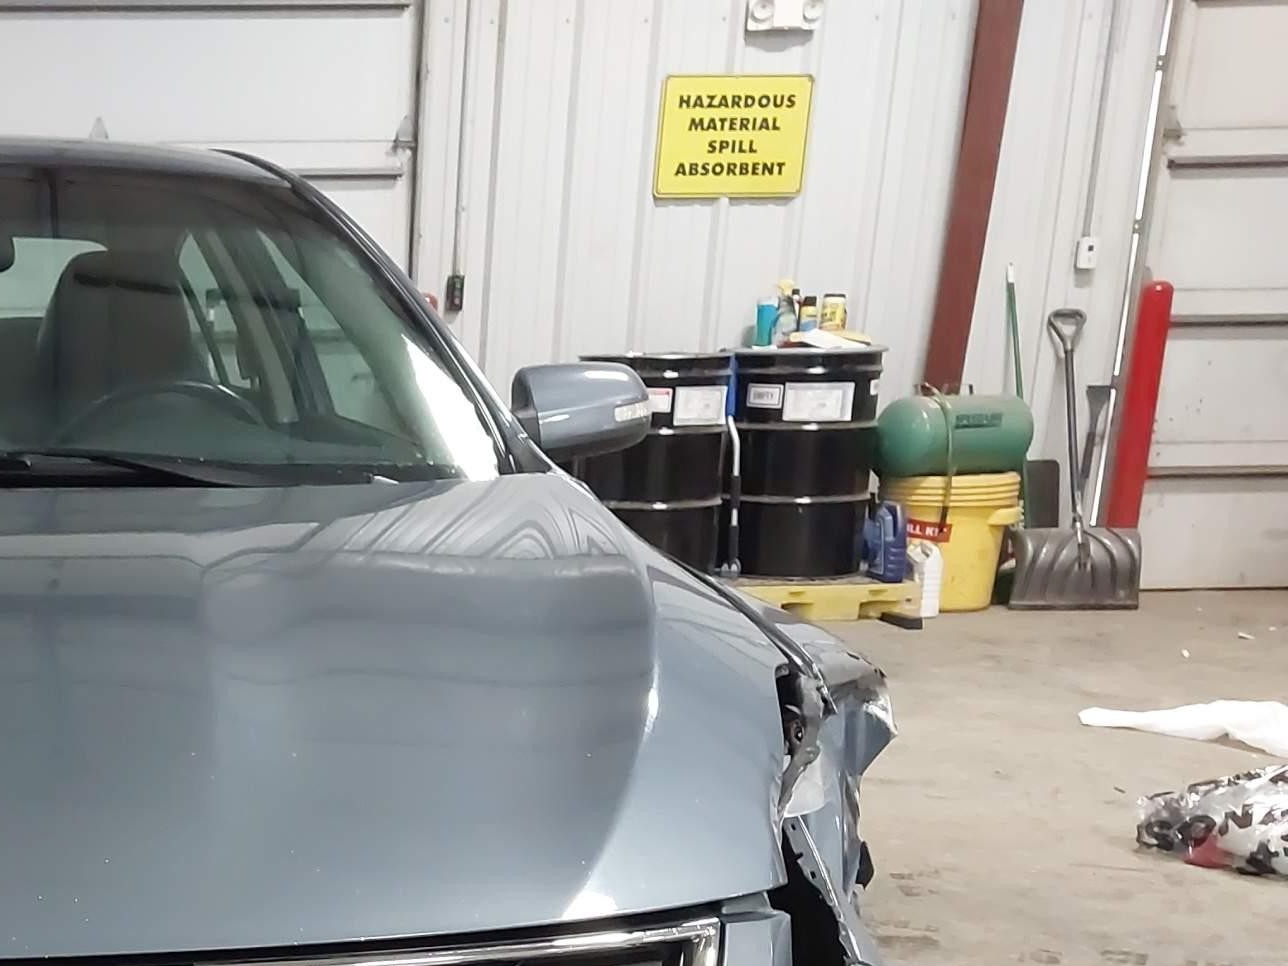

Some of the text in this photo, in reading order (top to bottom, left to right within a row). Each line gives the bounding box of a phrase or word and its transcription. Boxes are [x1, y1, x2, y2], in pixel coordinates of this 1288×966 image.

[678, 94, 796, 108] HAZARDOUS
[688, 117, 780, 132] MATERIAL
[707, 140, 758, 154] SPILL
[675, 162, 786, 176] ABSORBENT
